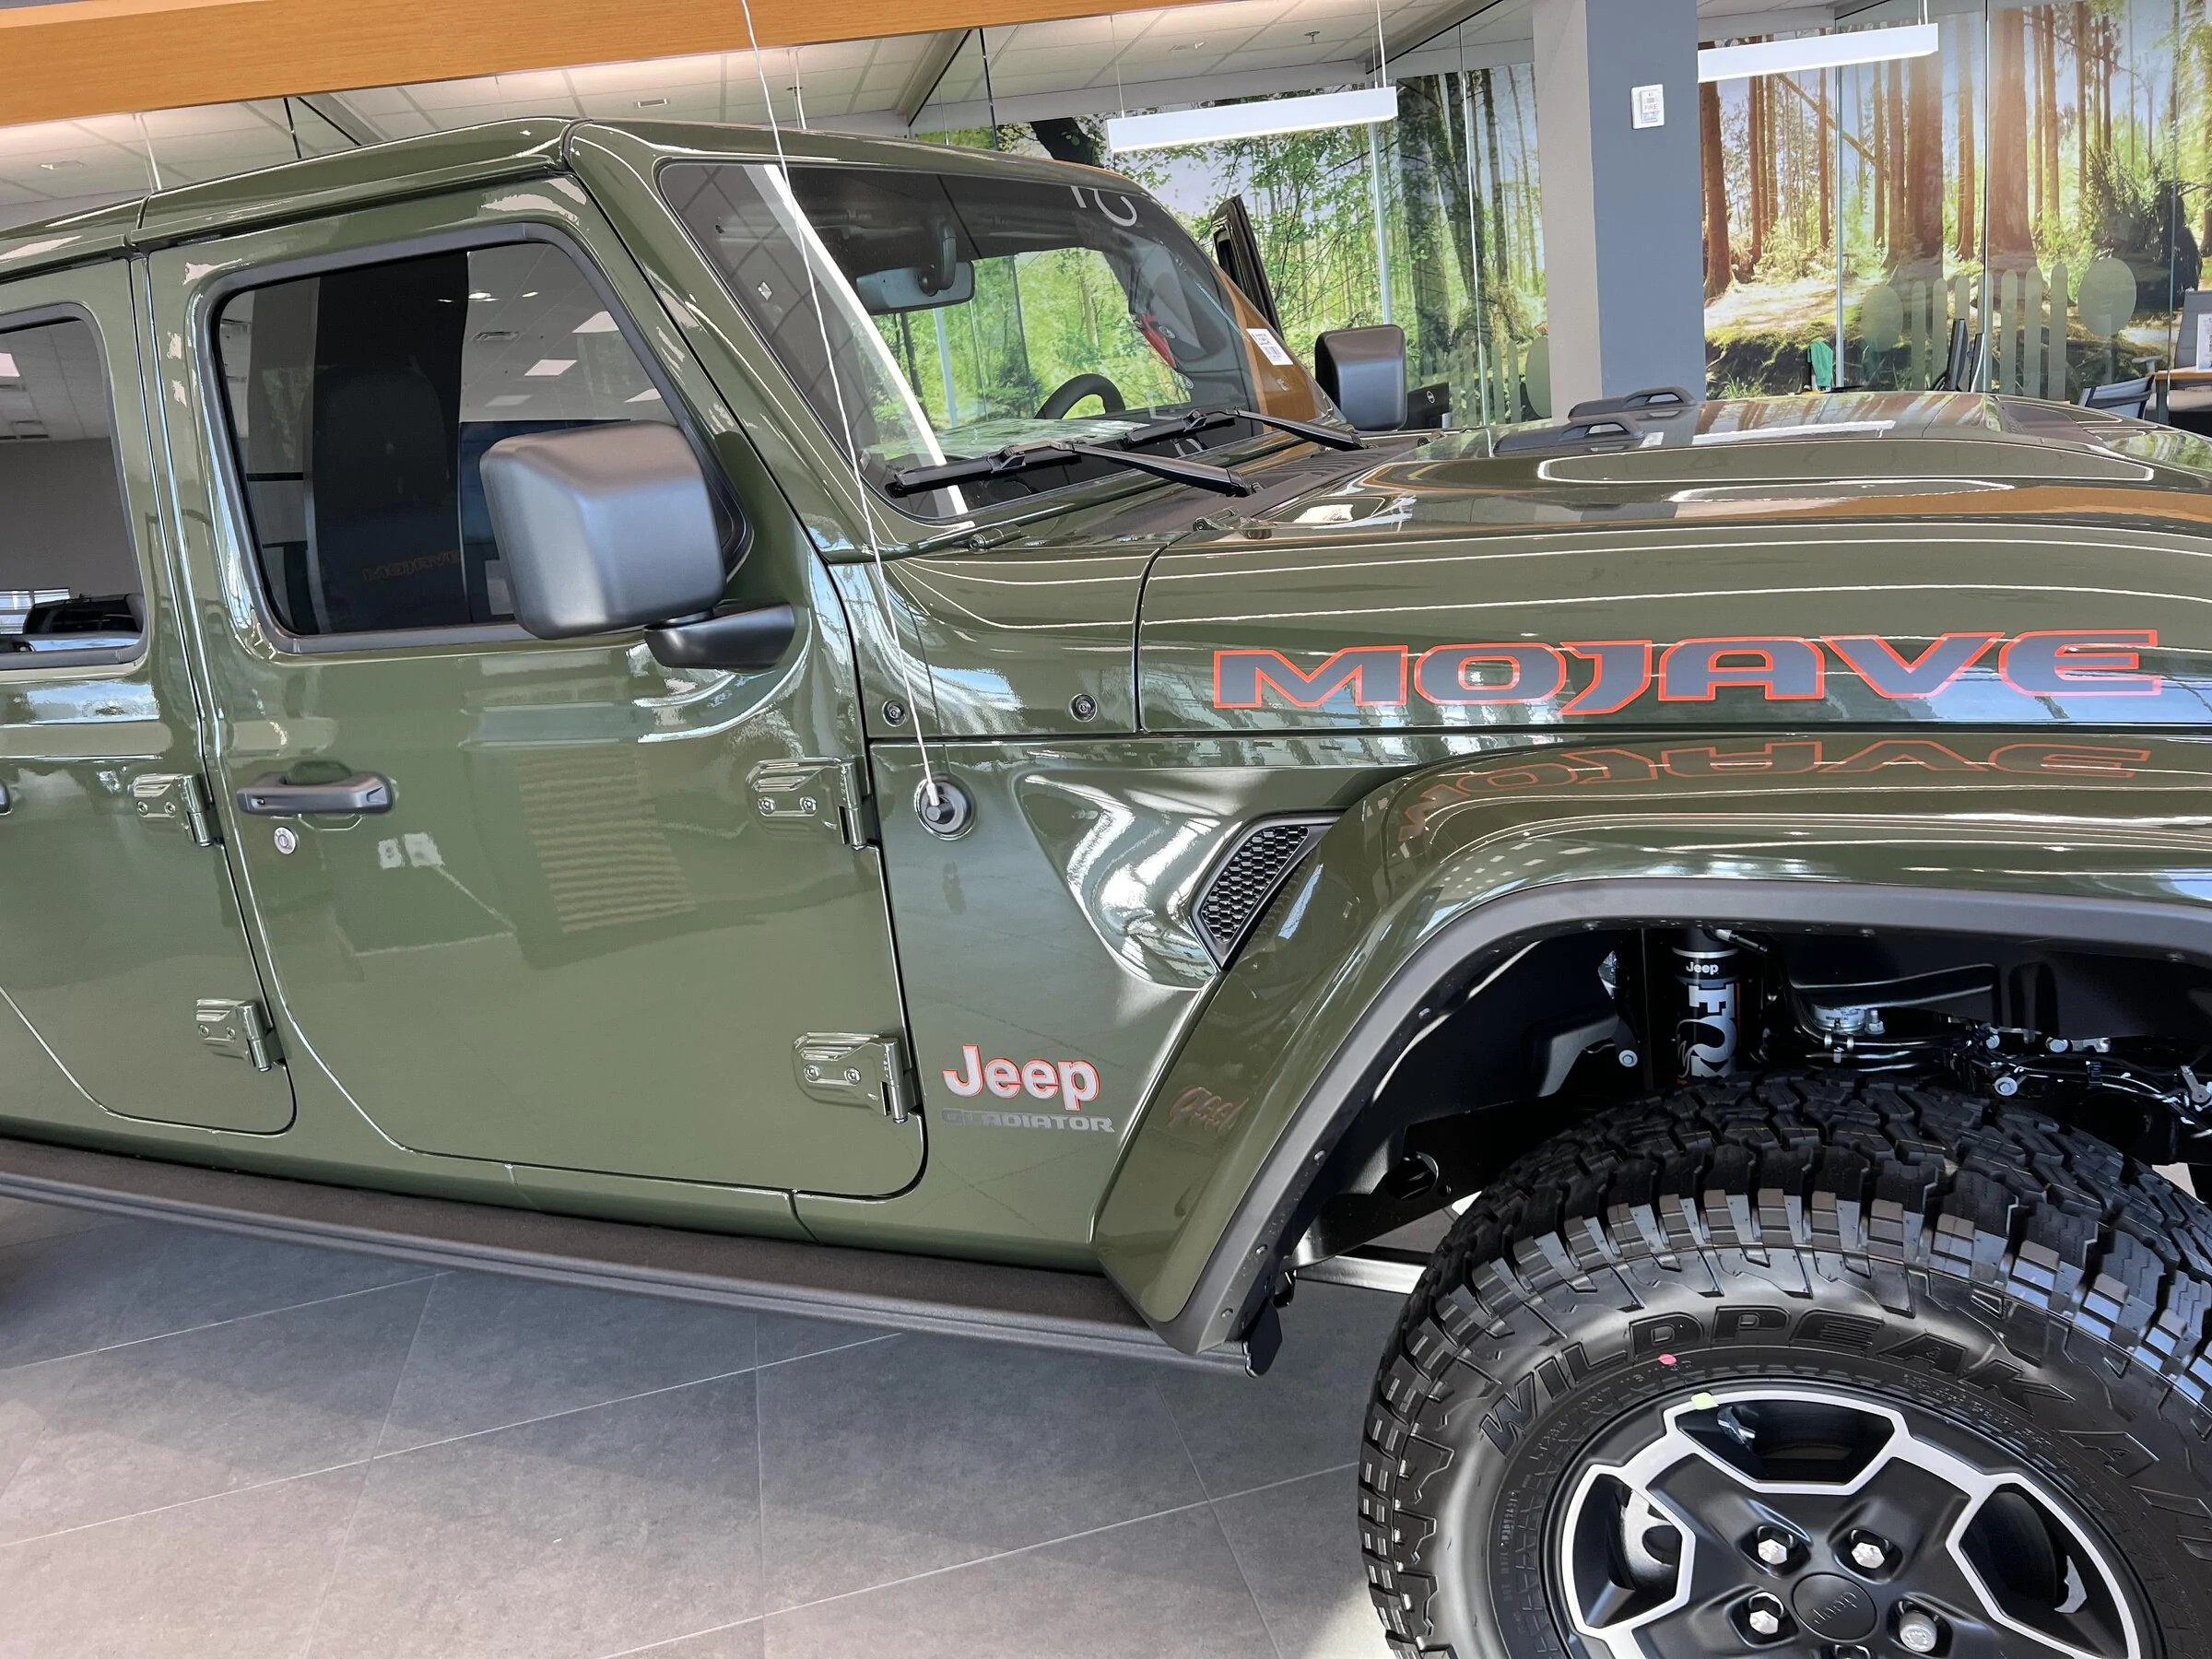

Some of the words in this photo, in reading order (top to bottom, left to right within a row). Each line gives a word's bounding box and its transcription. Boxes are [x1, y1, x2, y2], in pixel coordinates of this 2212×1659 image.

[1213, 629, 2161, 715] MOJAVE
[1685, 960, 1720, 975] Jeep
[942, 1043, 1100, 1112] Jeep
[942, 1107, 1115, 1134] GLADIATOR
[1478, 1303, 2076, 1460] WILDPEAK
[1811, 1591, 1859, 1626] Jeep
